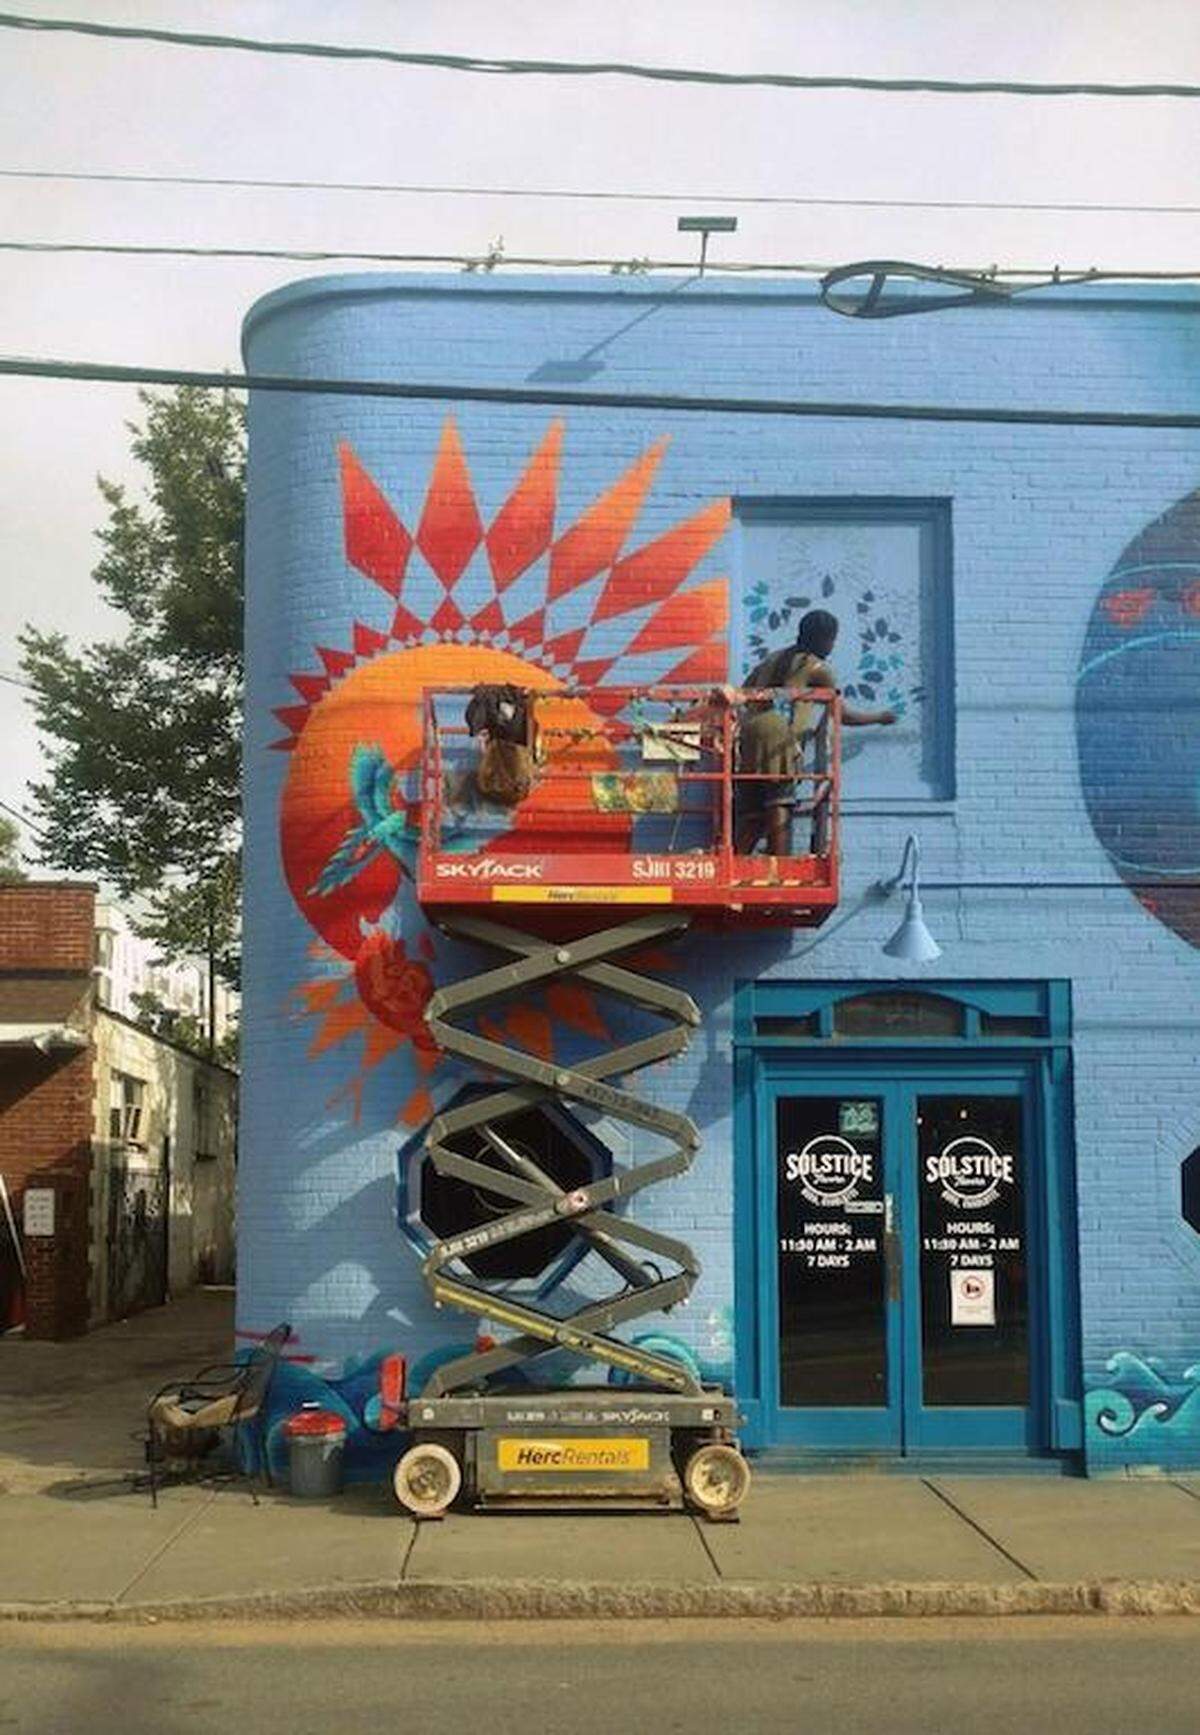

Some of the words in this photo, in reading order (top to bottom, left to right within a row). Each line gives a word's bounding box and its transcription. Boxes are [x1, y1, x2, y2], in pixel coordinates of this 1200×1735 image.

[435, 859, 542, 880] SKYJACK
[786, 1153, 873, 1182] SOLSTICE
[926, 1154, 1014, 1183] SOLSTICE
[804, 1222, 852, 1235] HOURS:
[946, 1222, 995, 1234] HOURS:
[815, 1239, 837, 1251] AM
[845, 1239, 854, 1251] 2
[855, 1239, 877, 1251] AM
[958, 1238, 980, 1250] AM
[988, 1238, 997, 1250] 2
[998, 1238, 1020, 1250] AM
[807, 1254, 816, 1267] 7
[817, 1254, 850, 1267] DAYS
[950, 1254, 959, 1267] 7
[960, 1254, 994, 1267] DAYS
